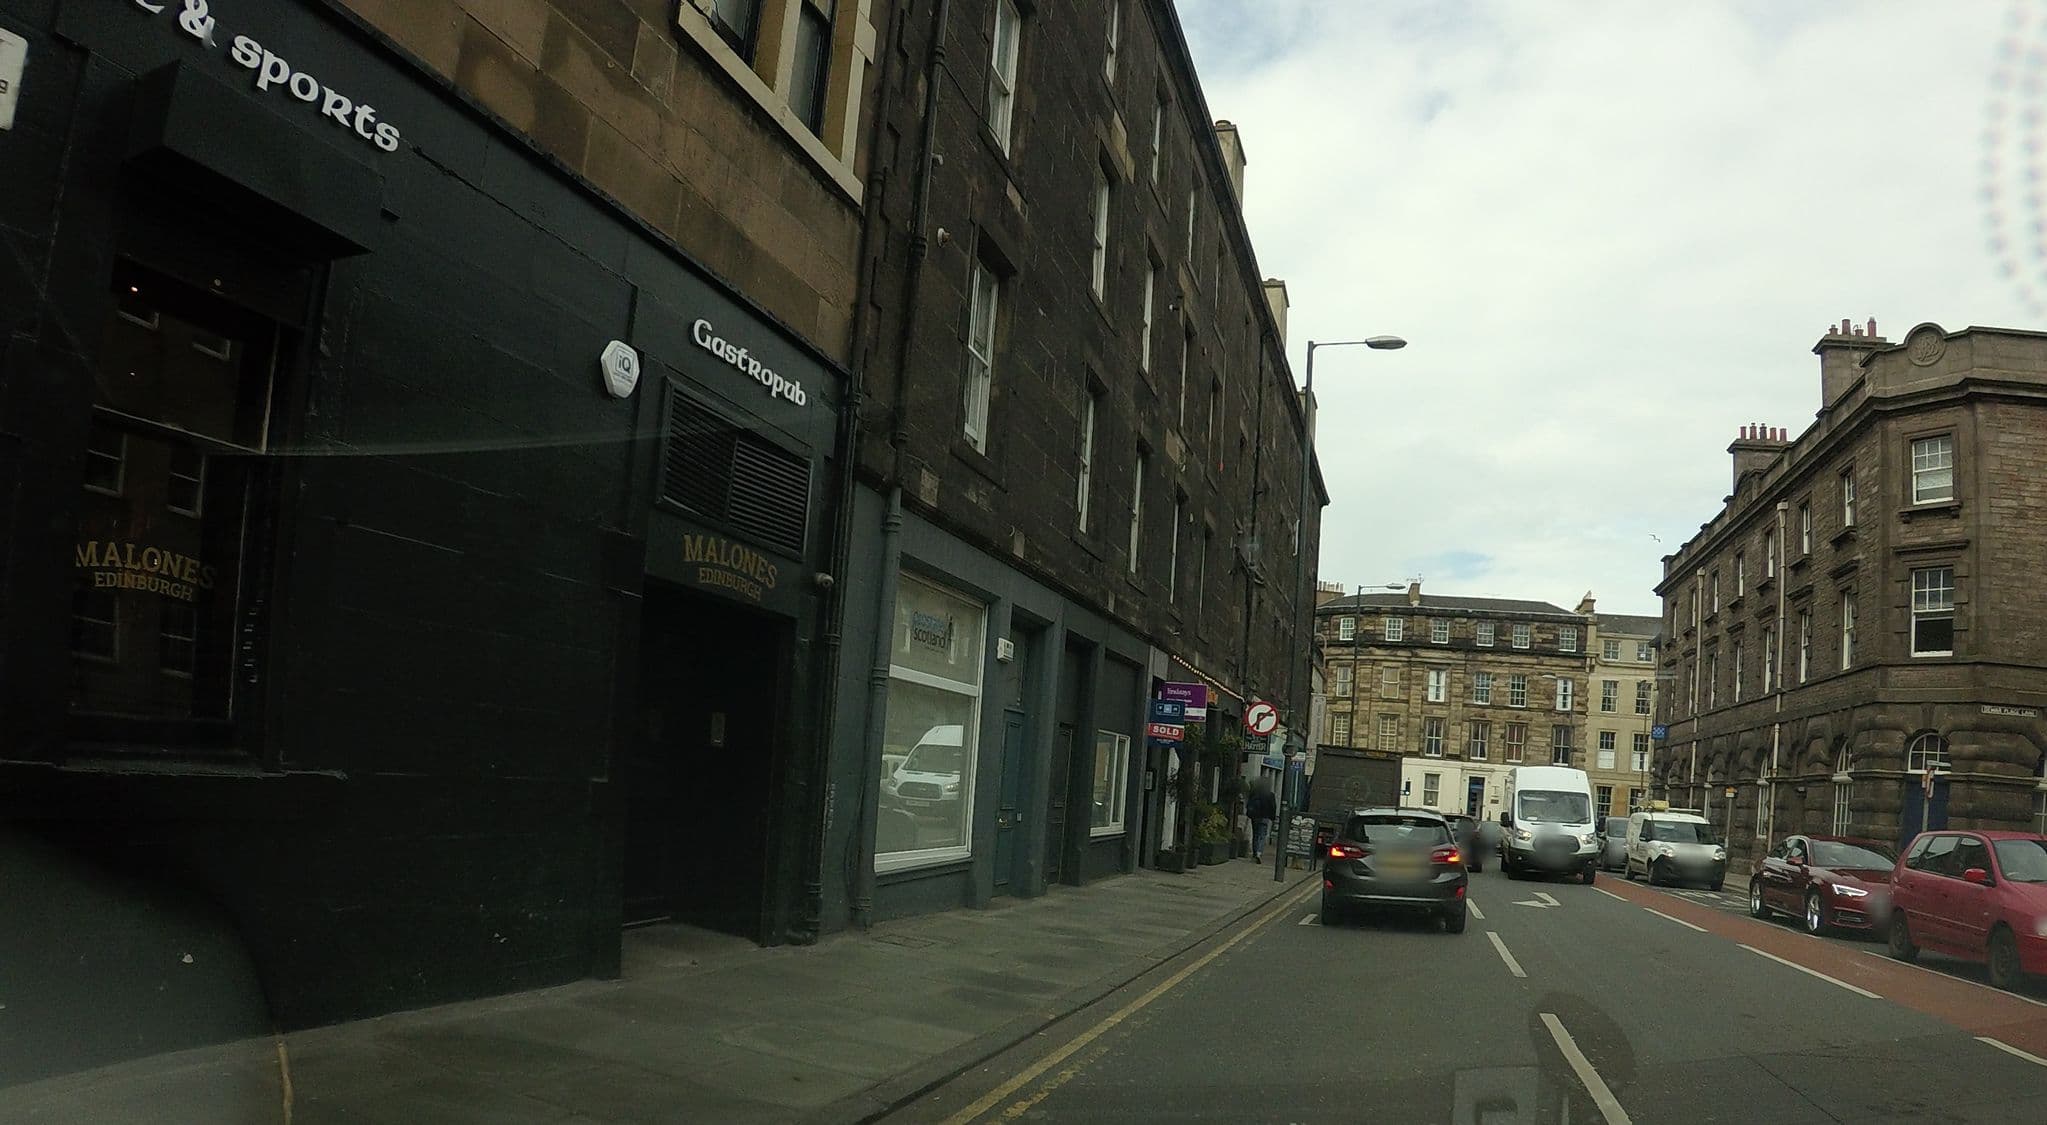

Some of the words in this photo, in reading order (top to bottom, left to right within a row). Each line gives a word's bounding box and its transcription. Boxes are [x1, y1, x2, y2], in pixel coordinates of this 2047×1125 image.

[179, 0, 216, 48] &
[231, 34, 401, 152] sports
[692, 318, 807, 407] Gastropub
[75, 540, 217, 590] MALONES
[682, 533, 779, 590] MALONES
[699, 566, 763, 602] EDINBURGH
[1152, 725, 1180, 736] SOLD
